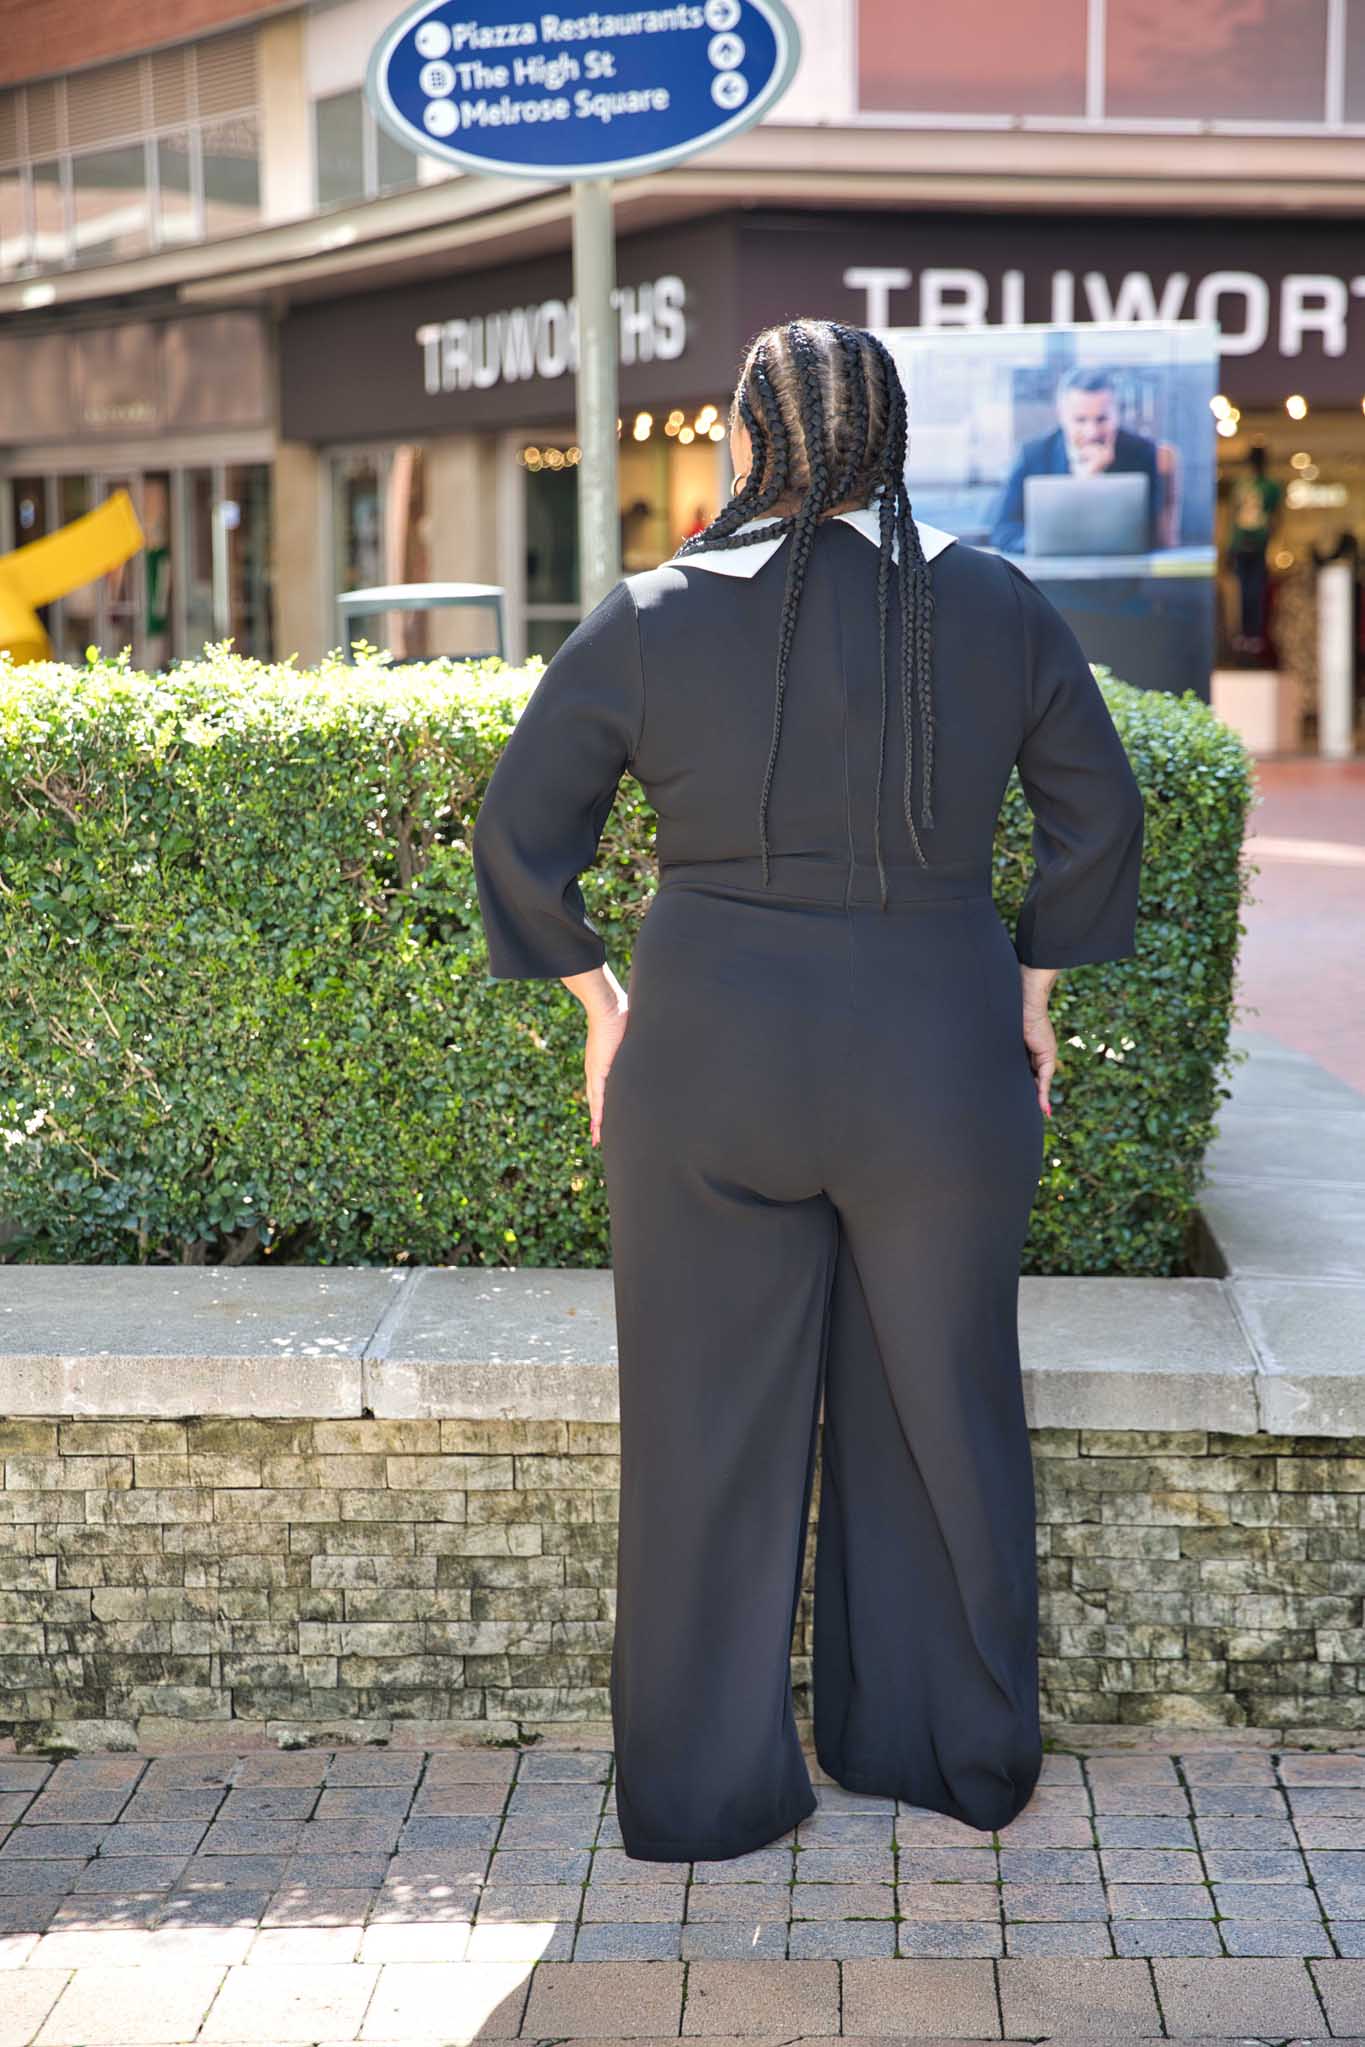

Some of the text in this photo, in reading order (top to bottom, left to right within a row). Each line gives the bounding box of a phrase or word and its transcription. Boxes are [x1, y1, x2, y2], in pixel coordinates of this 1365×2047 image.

[452, 4, 704, 51] Piazza Restaurants
[455, 50, 616, 90] The High St
[460, 88, 670, 129] Melrose Square
[843, 266, 1365, 357] TRUWOR
